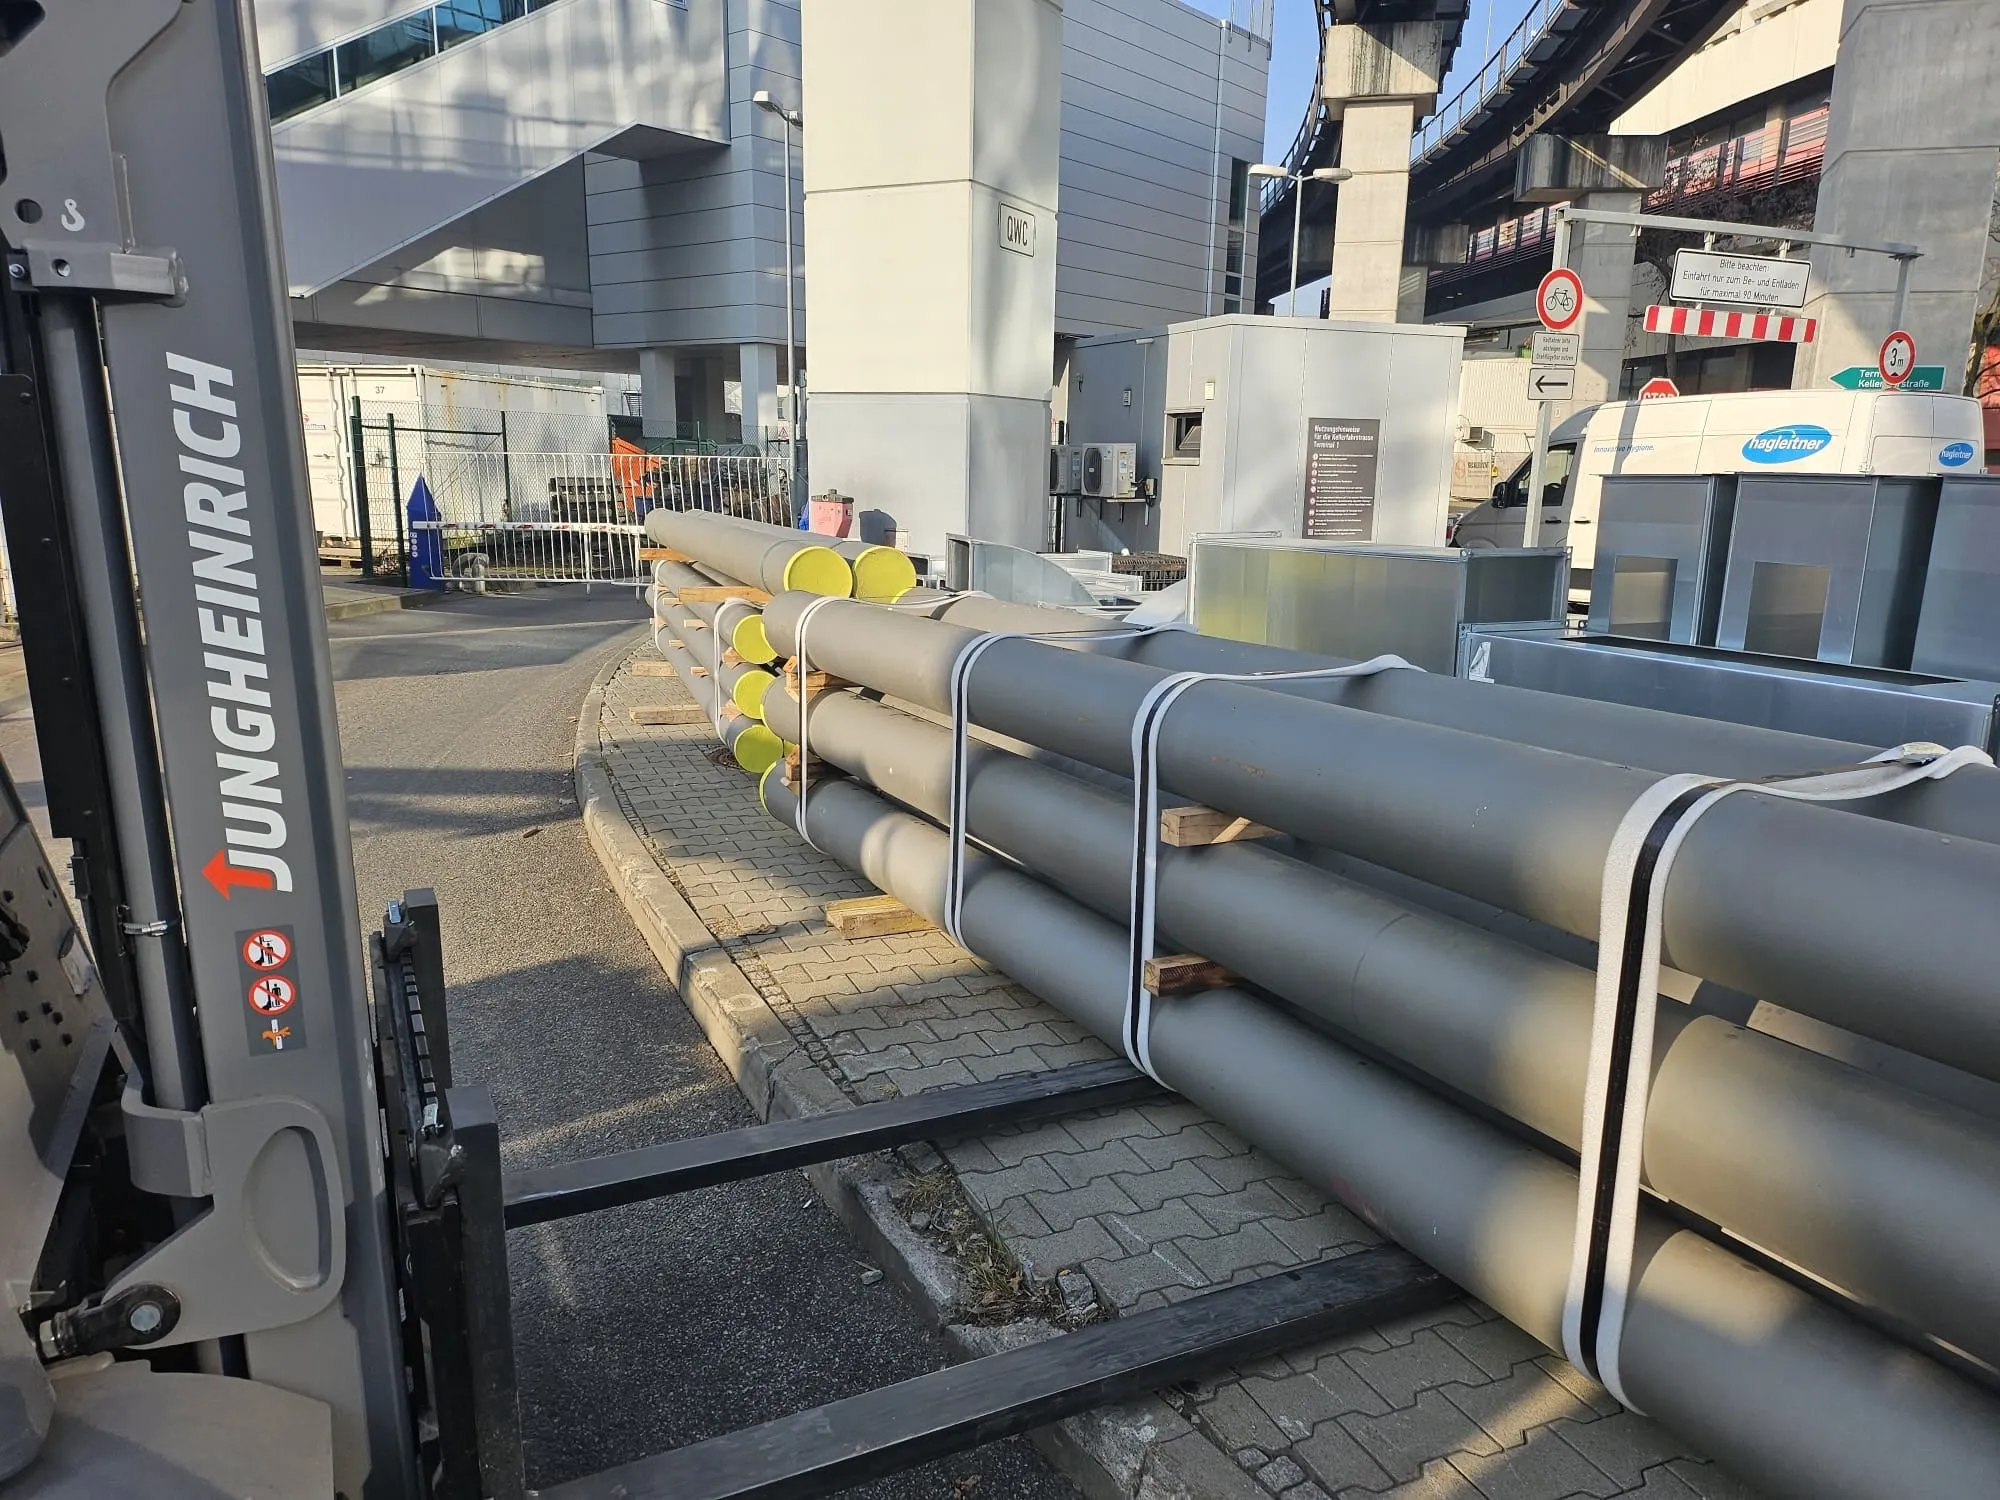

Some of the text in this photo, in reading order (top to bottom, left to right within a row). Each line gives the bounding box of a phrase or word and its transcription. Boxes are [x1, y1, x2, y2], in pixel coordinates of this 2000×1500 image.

[1007, 215, 1028, 246] QWC
[1720, 258, 1736, 269] Bitte
[1682, 270, 1711, 282] Einfahrt
[1712, 275, 1724, 283] nur
[1726, 276, 1740, 285] zum
[1758, 278, 1770, 288] und
[1772, 278, 1800, 290] Entladen
[1699, 286, 1779, 302] für maximal 90 Minuten
[1890, 347, 1898, 366] 3
[375, 386, 385, 394] 37
[1748, 432, 1824, 453] hagleitner
[166, 351, 293, 892] JUNGHEINRICH
